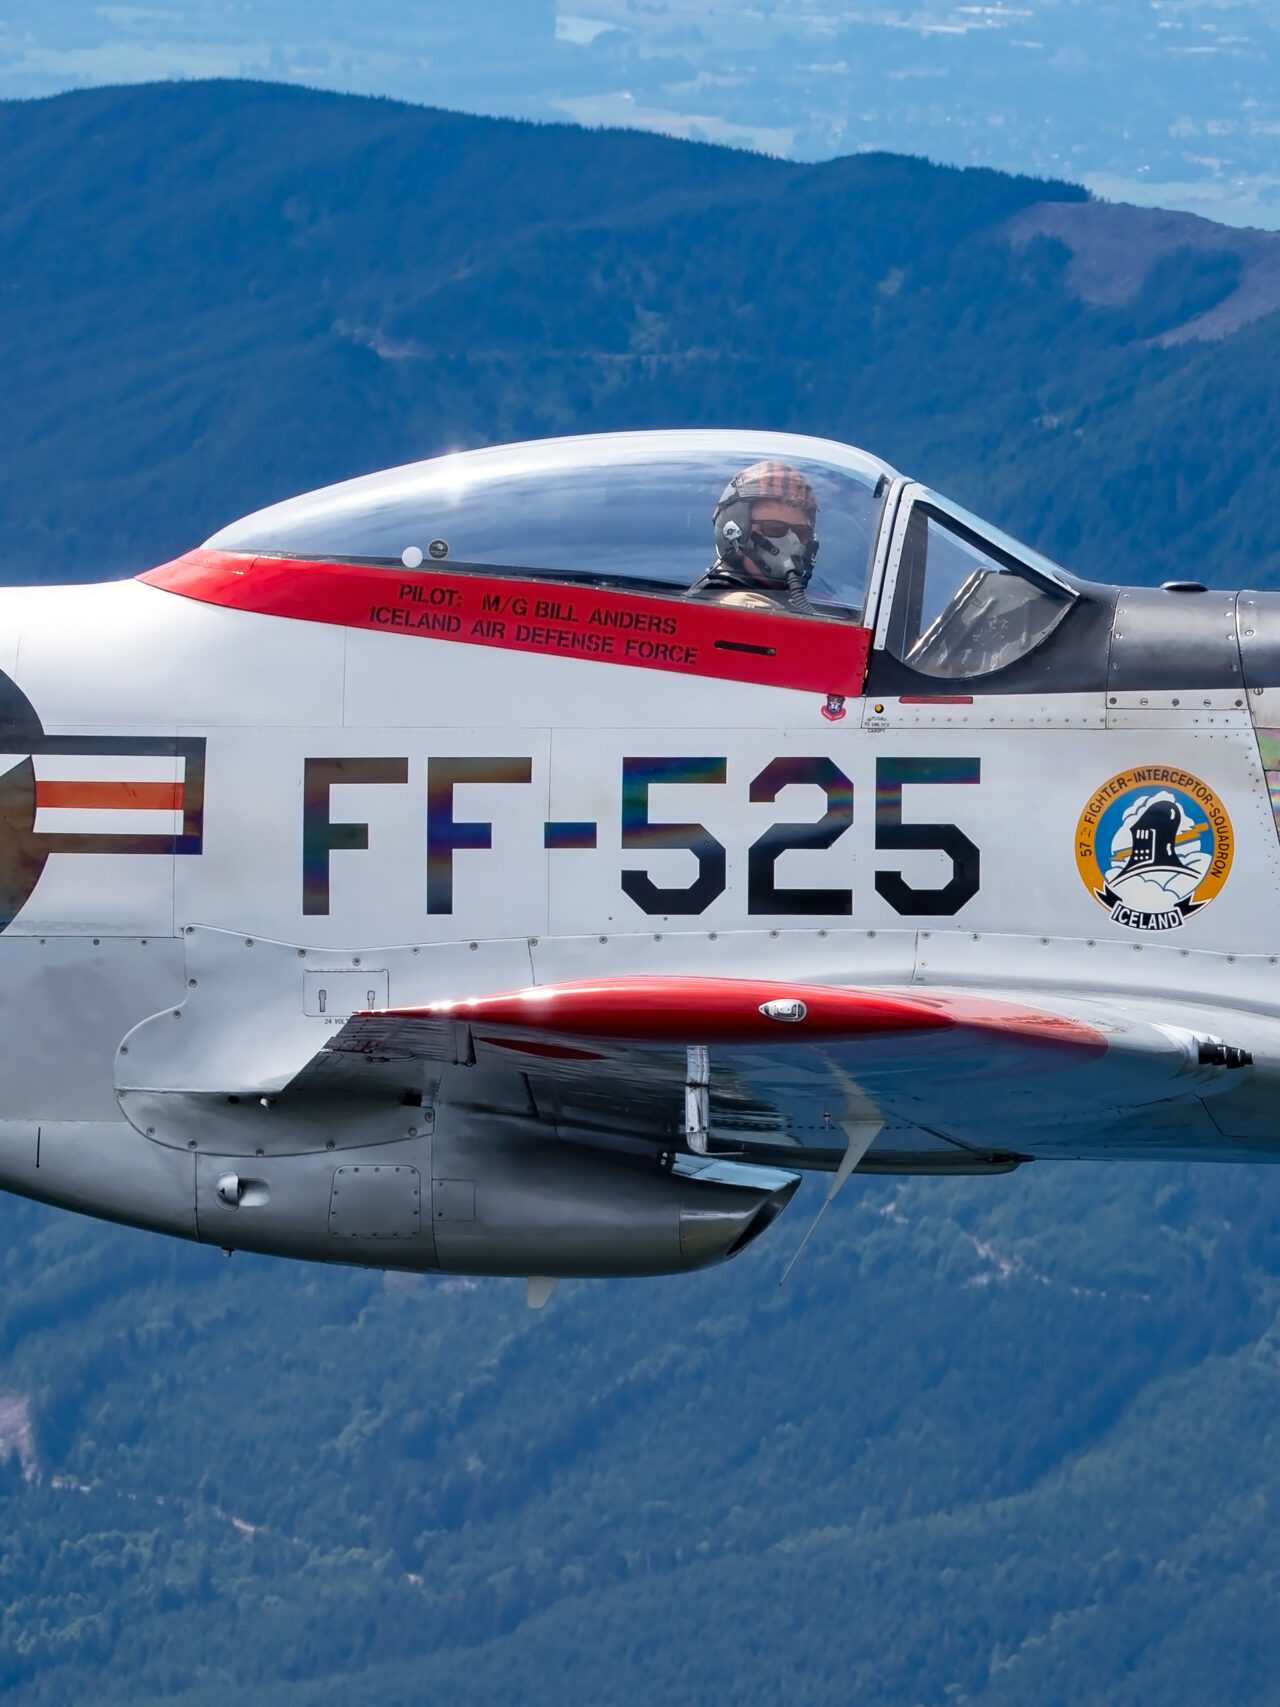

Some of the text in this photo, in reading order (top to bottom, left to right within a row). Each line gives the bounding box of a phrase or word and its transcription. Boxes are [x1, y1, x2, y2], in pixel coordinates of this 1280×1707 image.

[369, 606, 698, 665] ICELAND AIR DEFENSE FORCE
[399, 584, 678, 635] PILOT: M/G BILL ANDERS
[302, 757, 981, 916] FF-525
[1114, 906, 1180, 930] ICELAND
